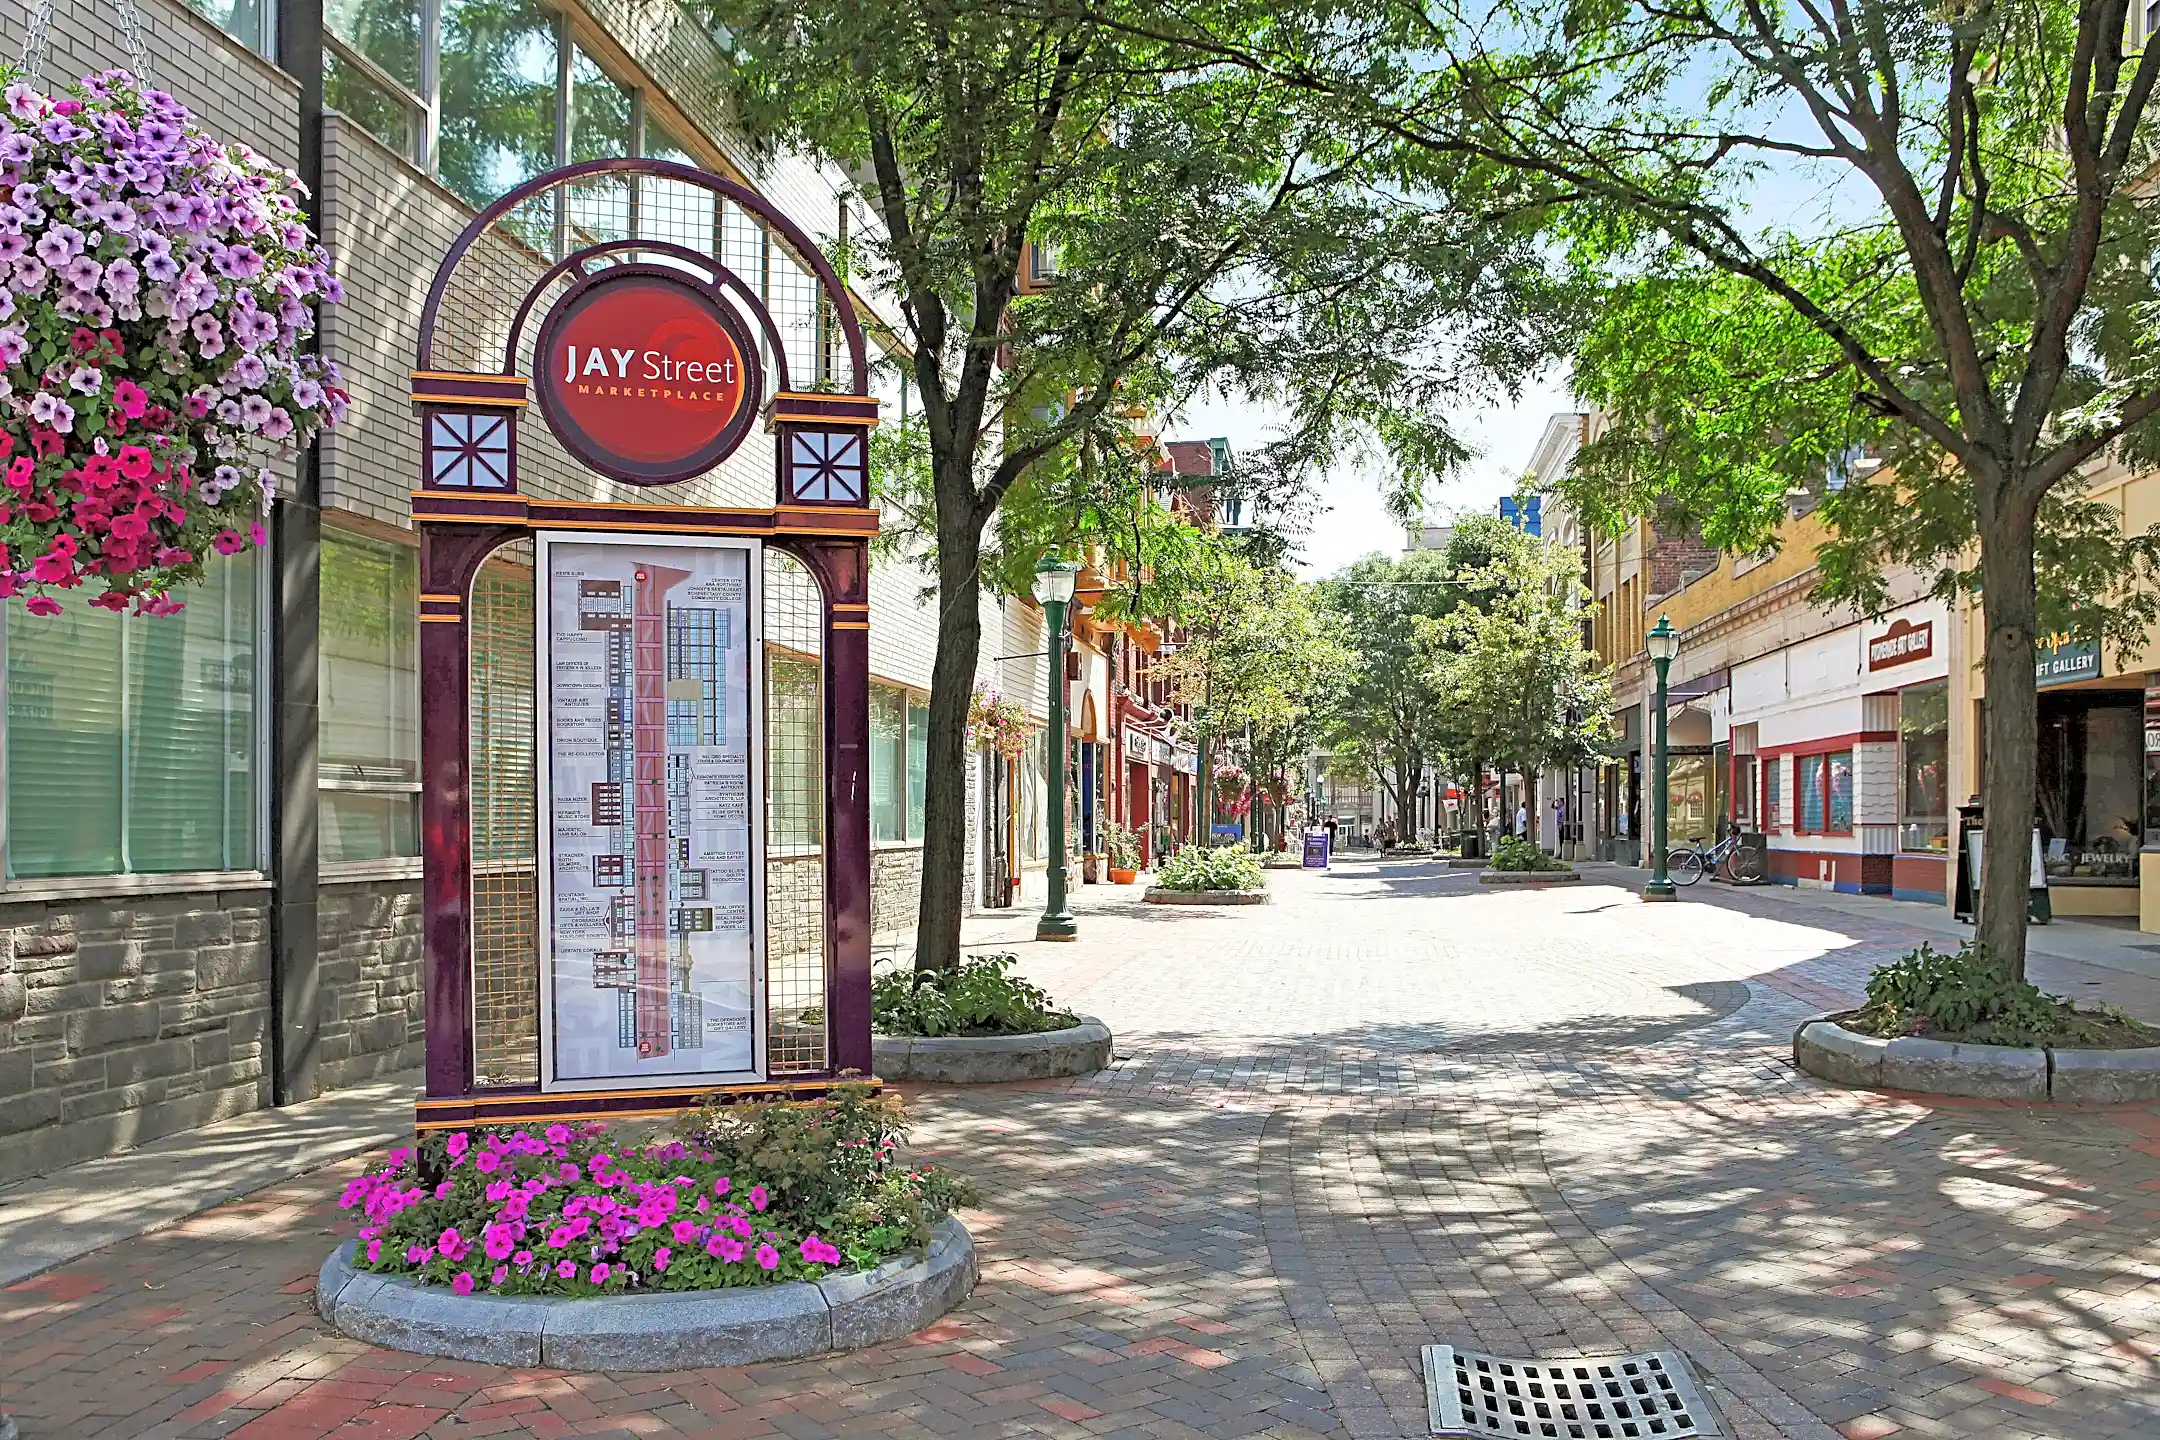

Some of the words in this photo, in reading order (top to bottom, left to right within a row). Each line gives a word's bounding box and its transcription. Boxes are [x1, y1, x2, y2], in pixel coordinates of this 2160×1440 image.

[564, 345, 636, 384] JAY
[643, 350, 735, 384] Street
[578, 384, 724, 402] MARKETPLACE
[2036, 662, 2050, 677] IFT
[2053, 654, 2094, 674] GALLERY
[2081, 852, 2130, 864] JEWELRY
